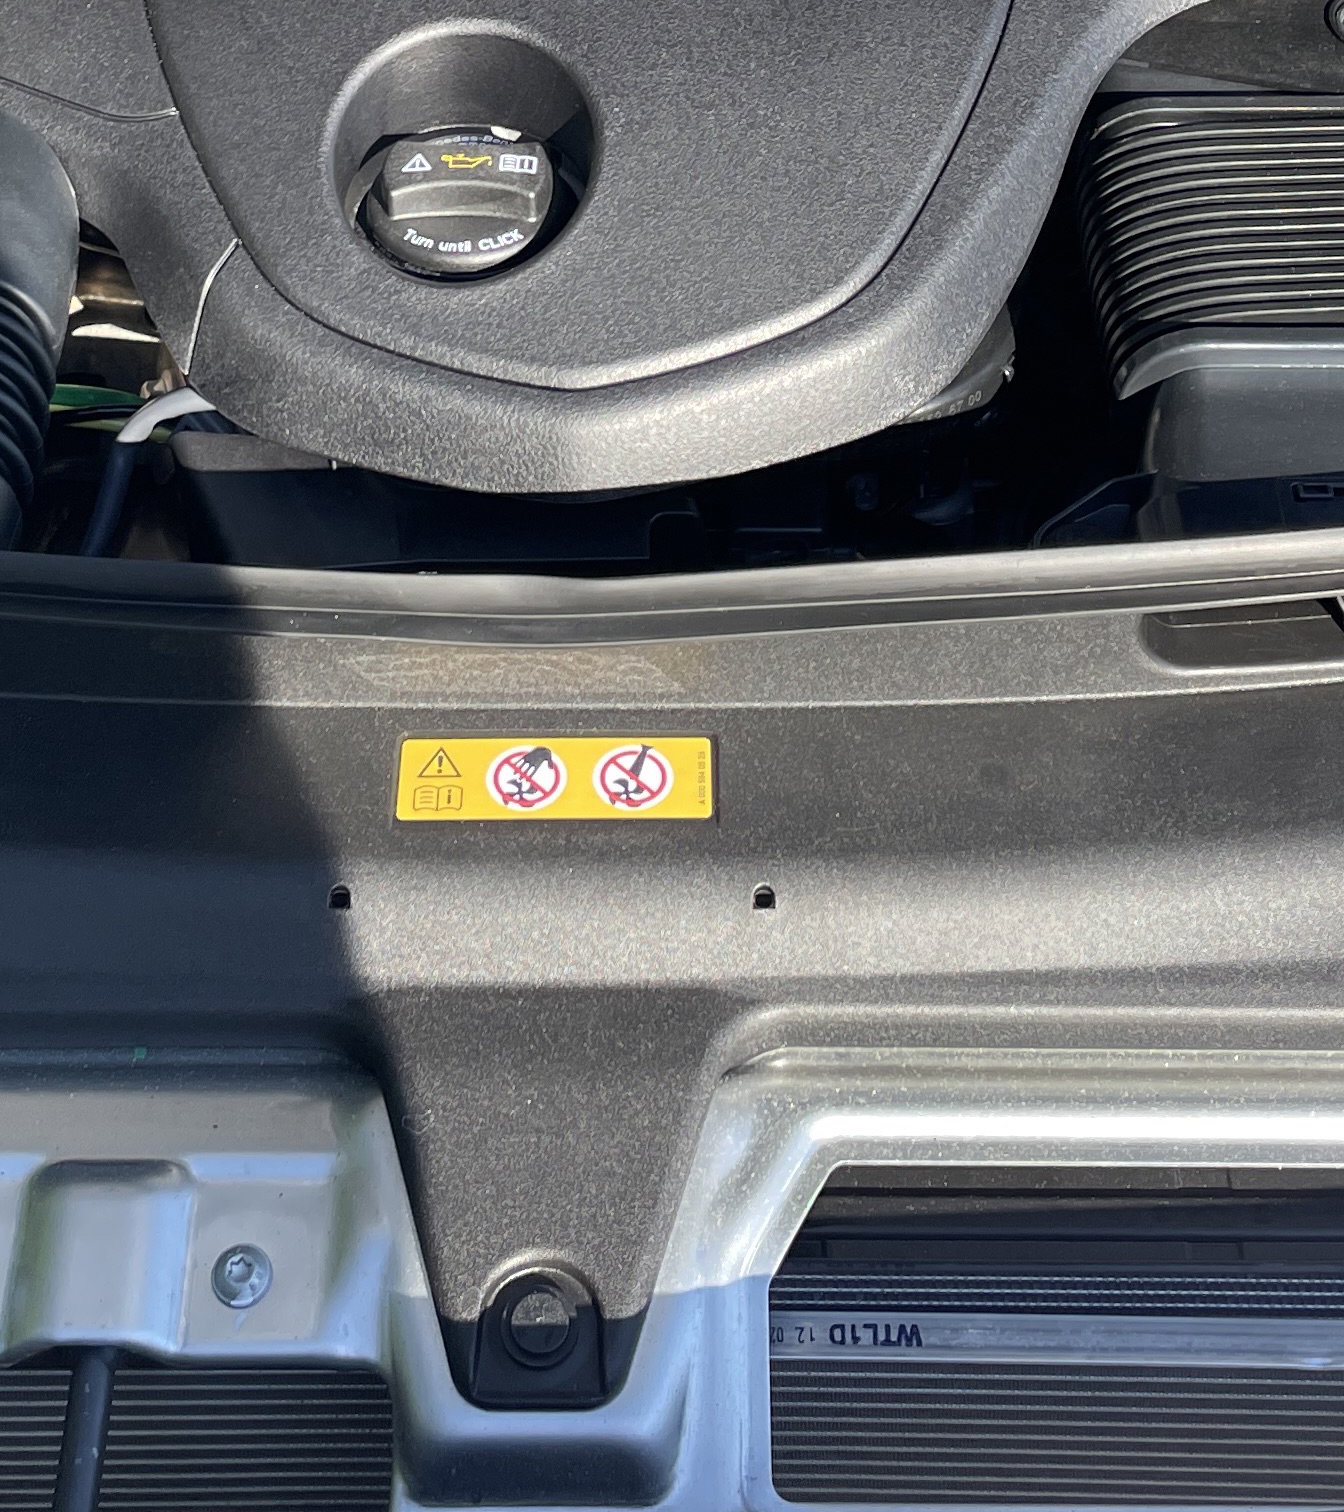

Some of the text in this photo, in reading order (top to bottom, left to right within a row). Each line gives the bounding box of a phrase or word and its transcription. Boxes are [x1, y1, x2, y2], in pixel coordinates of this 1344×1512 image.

[403, 228, 524, 252] Turn until CLICK
[829, 1323, 923, 1347] WTL1D
